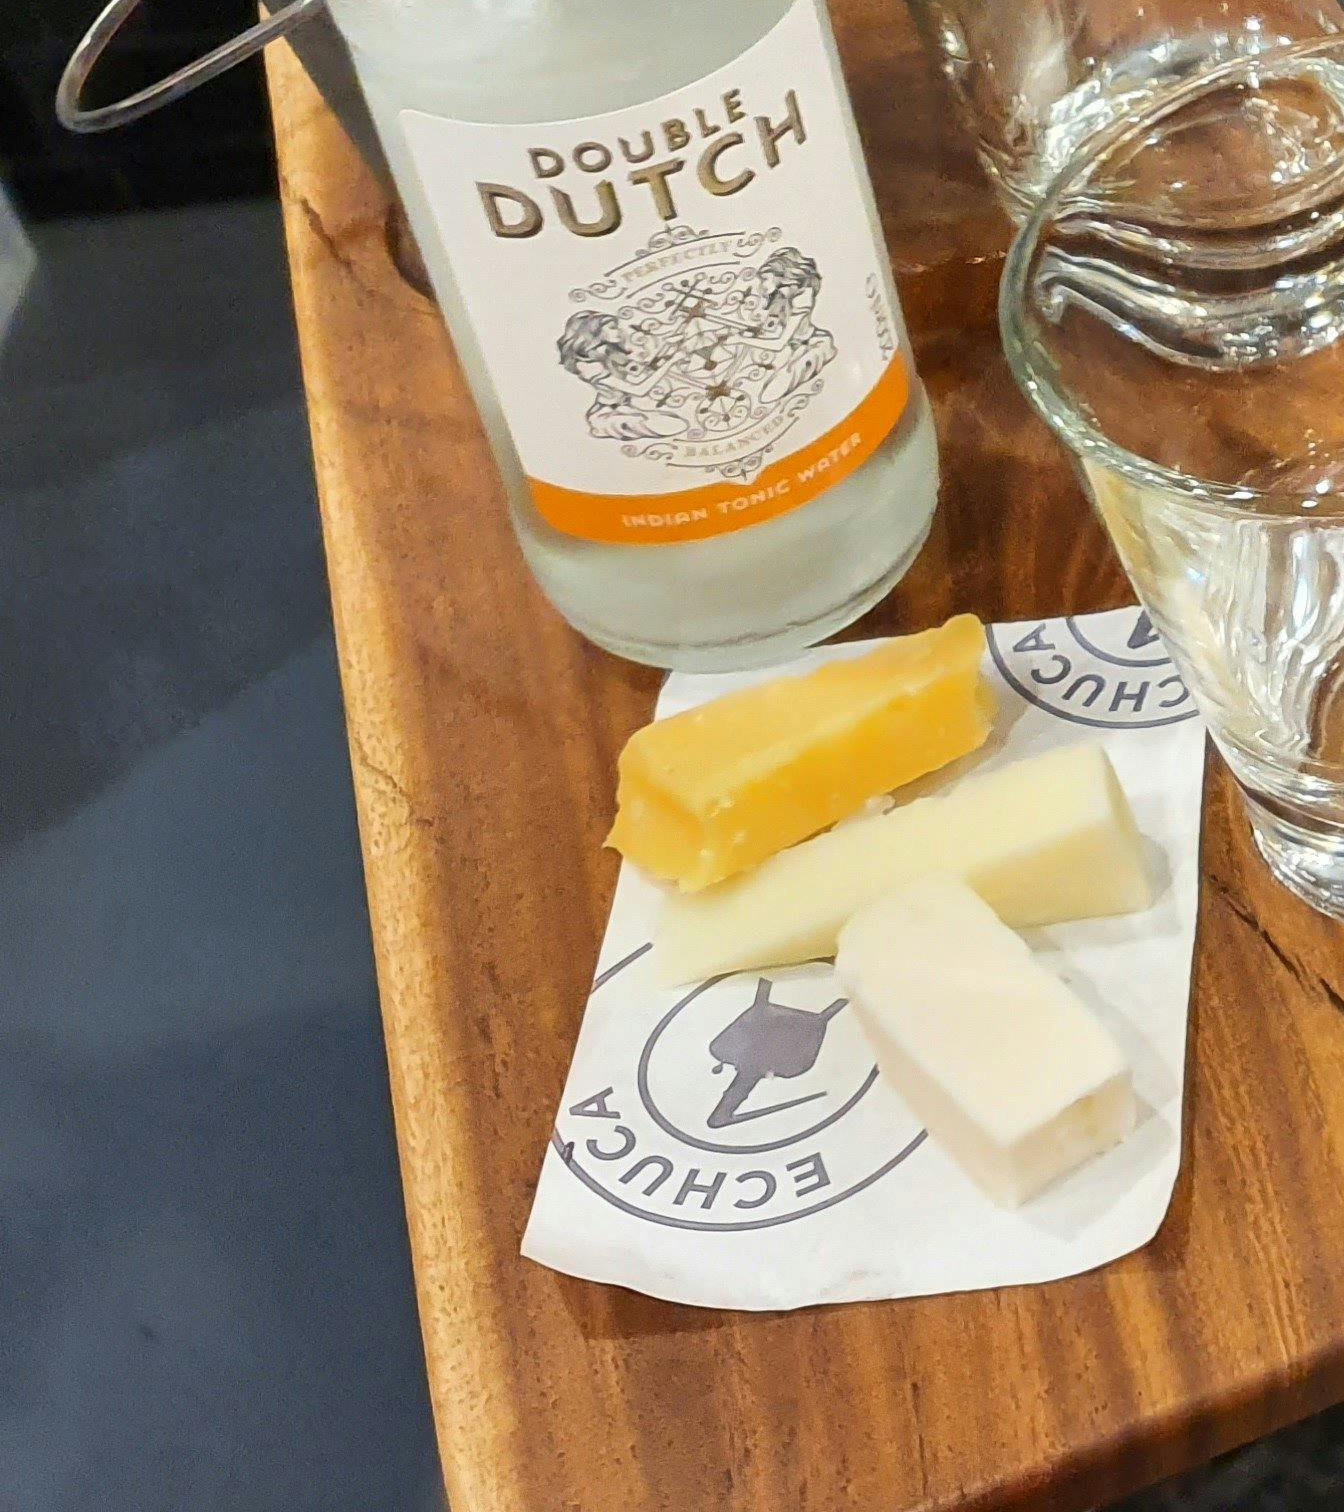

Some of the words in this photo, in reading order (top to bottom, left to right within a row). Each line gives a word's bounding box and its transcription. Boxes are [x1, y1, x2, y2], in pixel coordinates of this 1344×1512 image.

[475, 89, 807, 238] DUTCH
[528, 88, 747, 178] DOUBLE
[622, 507, 709, 528] INDIAN
[716, 479, 791, 514] TONIC
[797, 432, 862, 484] WATER
[1012, 623, 1190, 712] CHUCA
[569, 1086, 831, 1210] ECHUCA
